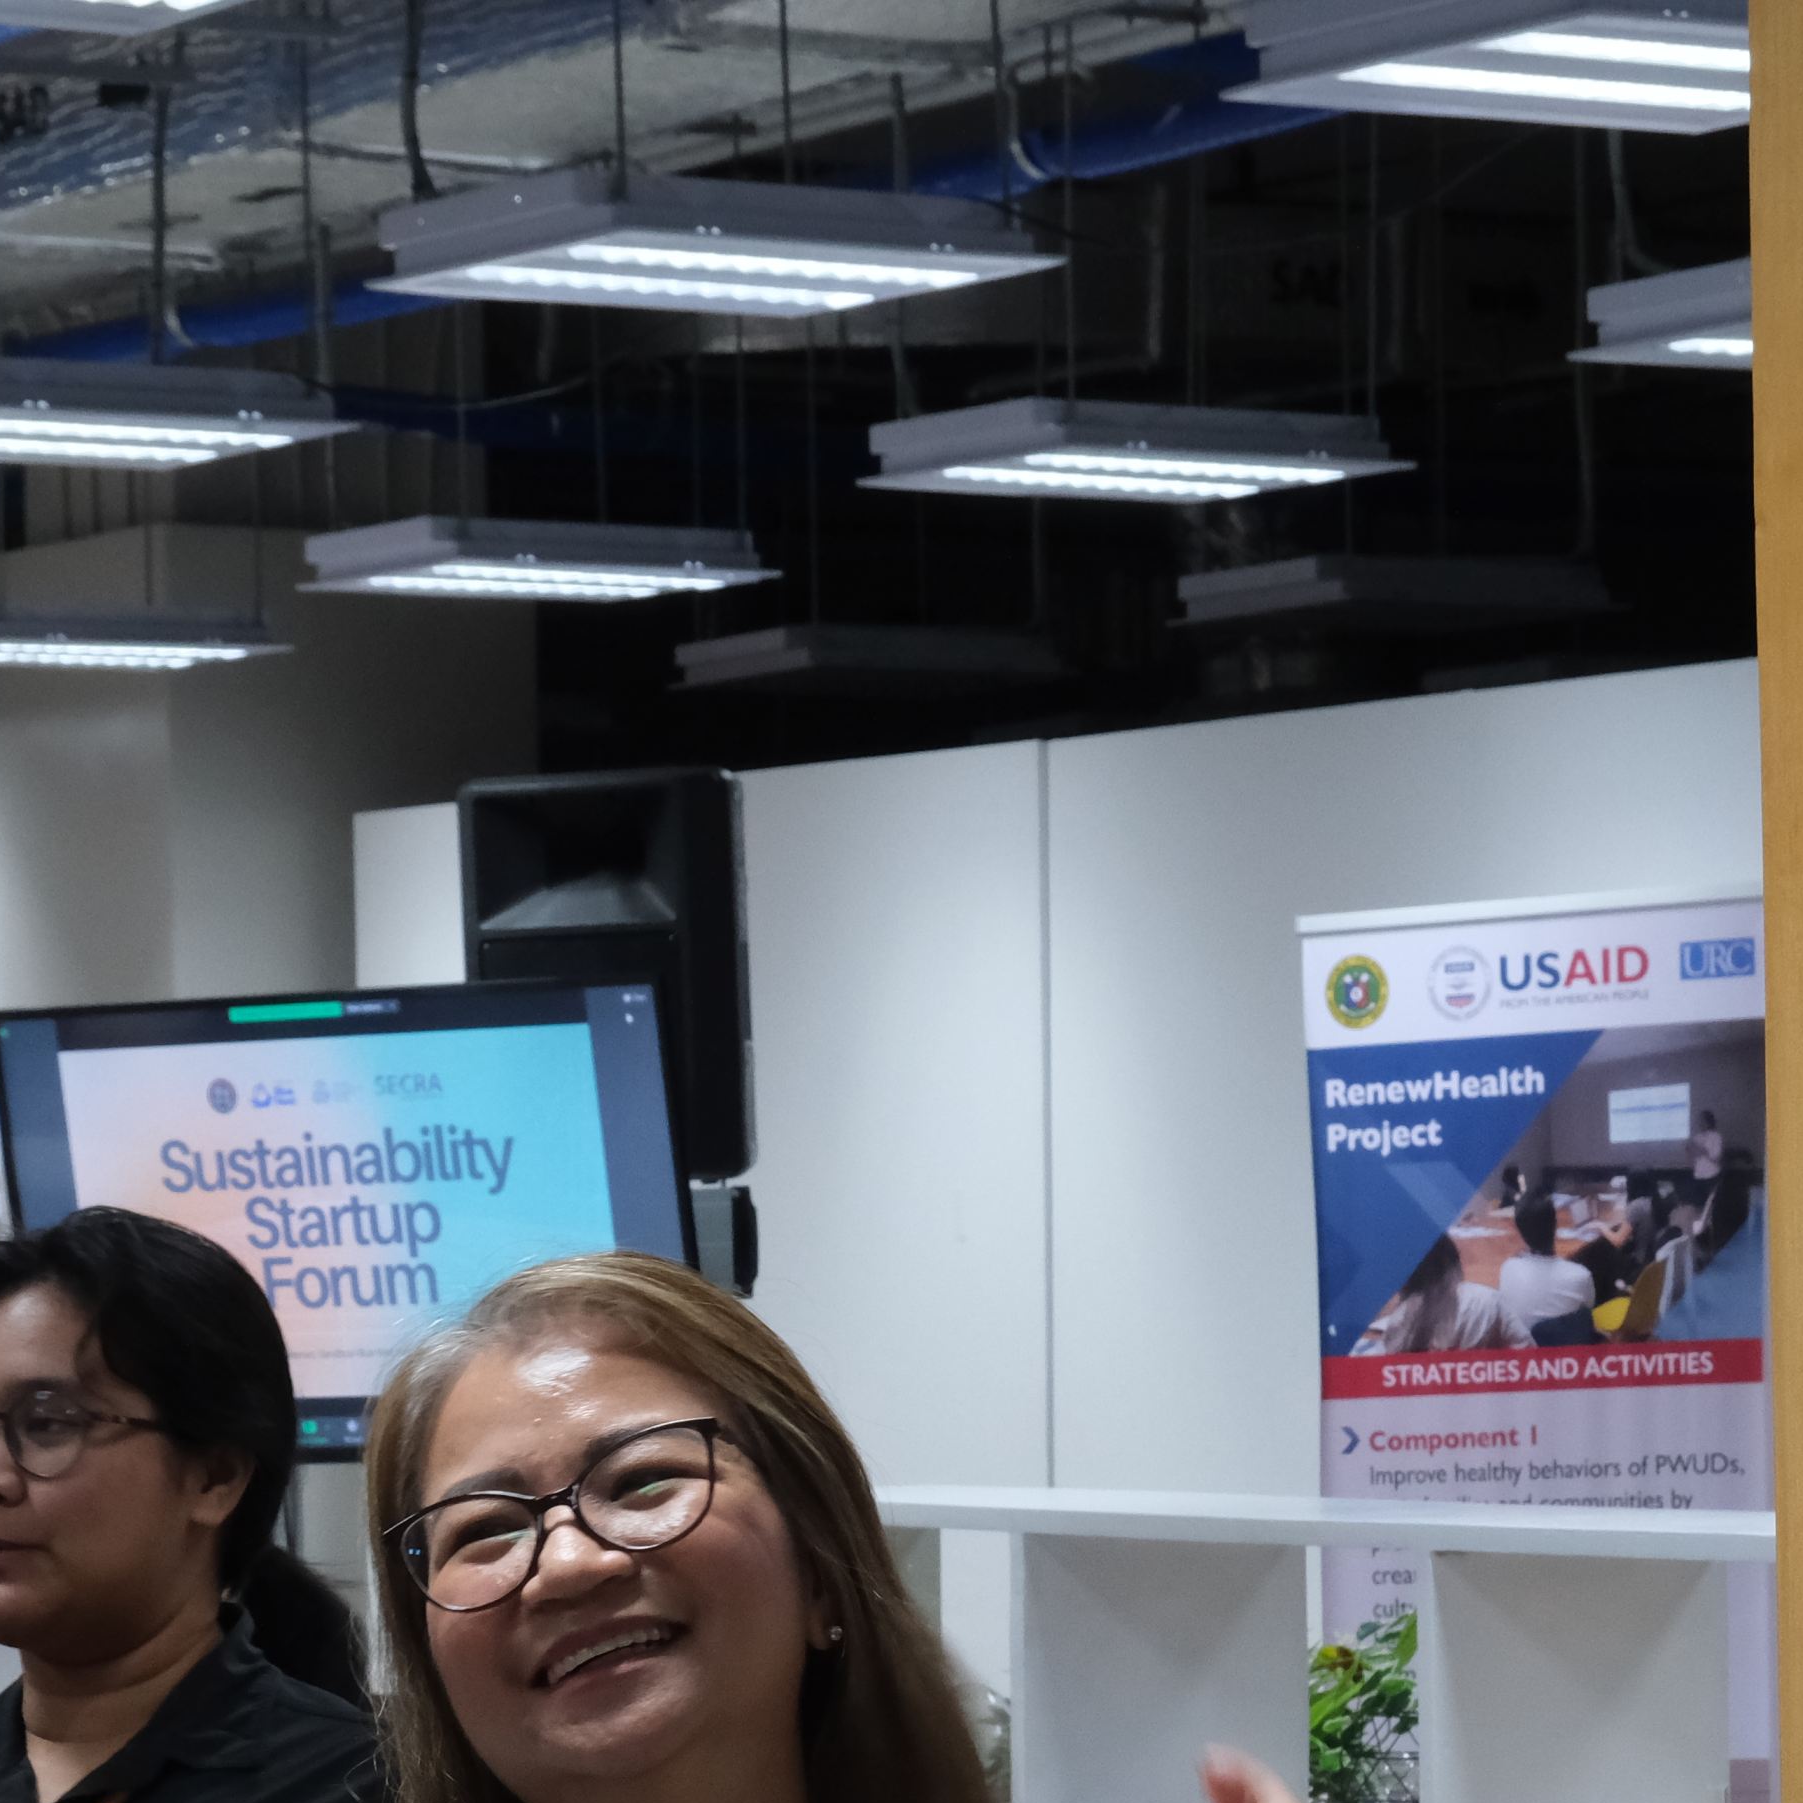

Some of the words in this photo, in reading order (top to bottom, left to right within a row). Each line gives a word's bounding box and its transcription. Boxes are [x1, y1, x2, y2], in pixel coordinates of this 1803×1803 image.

[1499, 945, 1649, 991] USAID
[1683, 940, 1752, 978] URC
[1325, 1065, 1546, 1108] RenewHealth
[1326, 1119, 1443, 1157] Project
[160, 1124, 515, 1195] Sustainability
[246, 1191, 441, 1258] Startup
[262, 1257, 440, 1310] Forum
[1382, 1359, 1521, 1388] STRATEGIES
[1525, 1355, 1579, 1380] AND
[1584, 1351, 1714, 1378] ACTIVITIES
[1369, 1426, 1520, 1457] Component
[1370, 1466, 1447, 1491] Improve
[1454, 1461, 1522, 1487] healthy
[1528, 1458, 1621, 1480] behaviors
[1628, 1455, 1649, 1477] of
[1655, 1451, 1745, 1476] PWUDs,
[1372, 1569, 1416, 1585] crea
